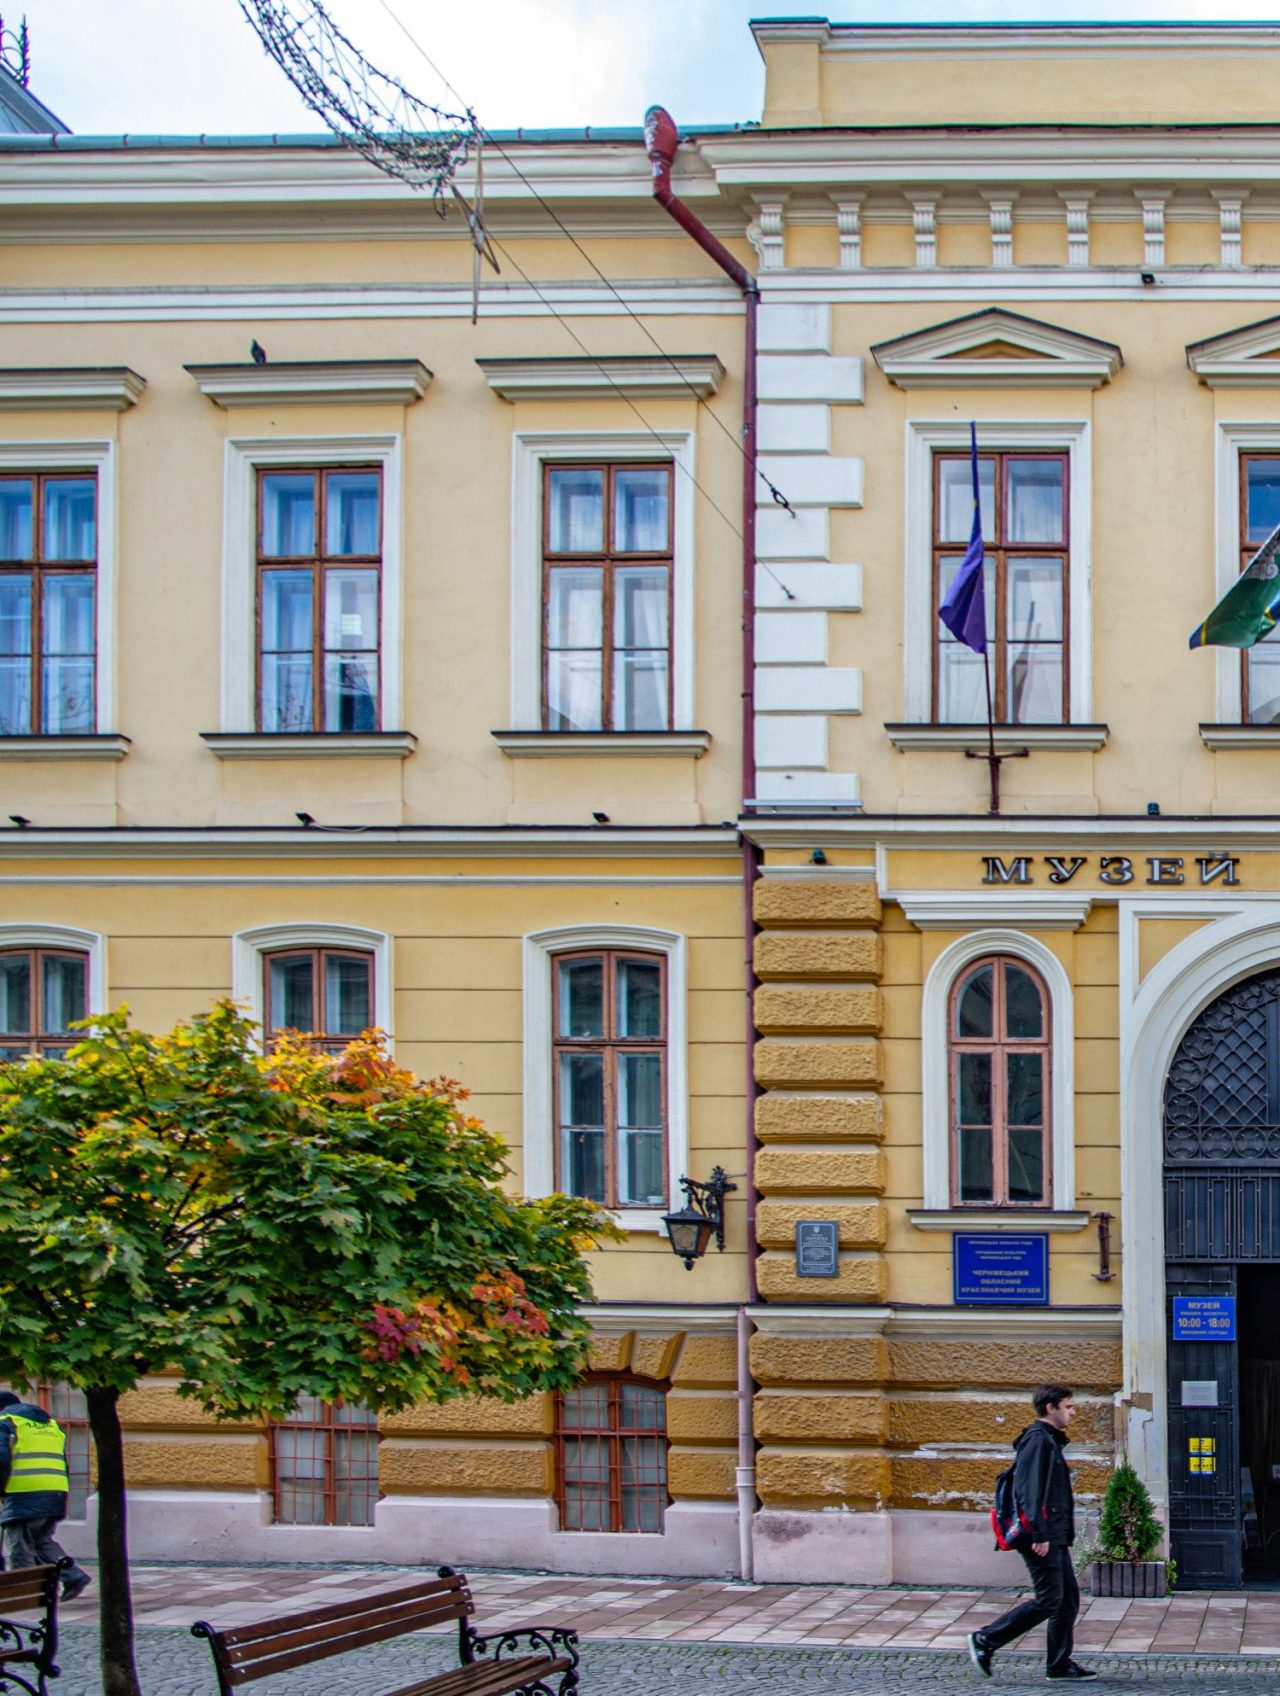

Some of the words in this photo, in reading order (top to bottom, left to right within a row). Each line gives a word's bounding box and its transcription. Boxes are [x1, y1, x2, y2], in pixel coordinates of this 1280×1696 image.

[981, 852, 1241, 885] МУЗЕЙ
[1178, 1318, 1201, 1327] 10:00
[1208, 1318, 1230, 1328] 18:00
